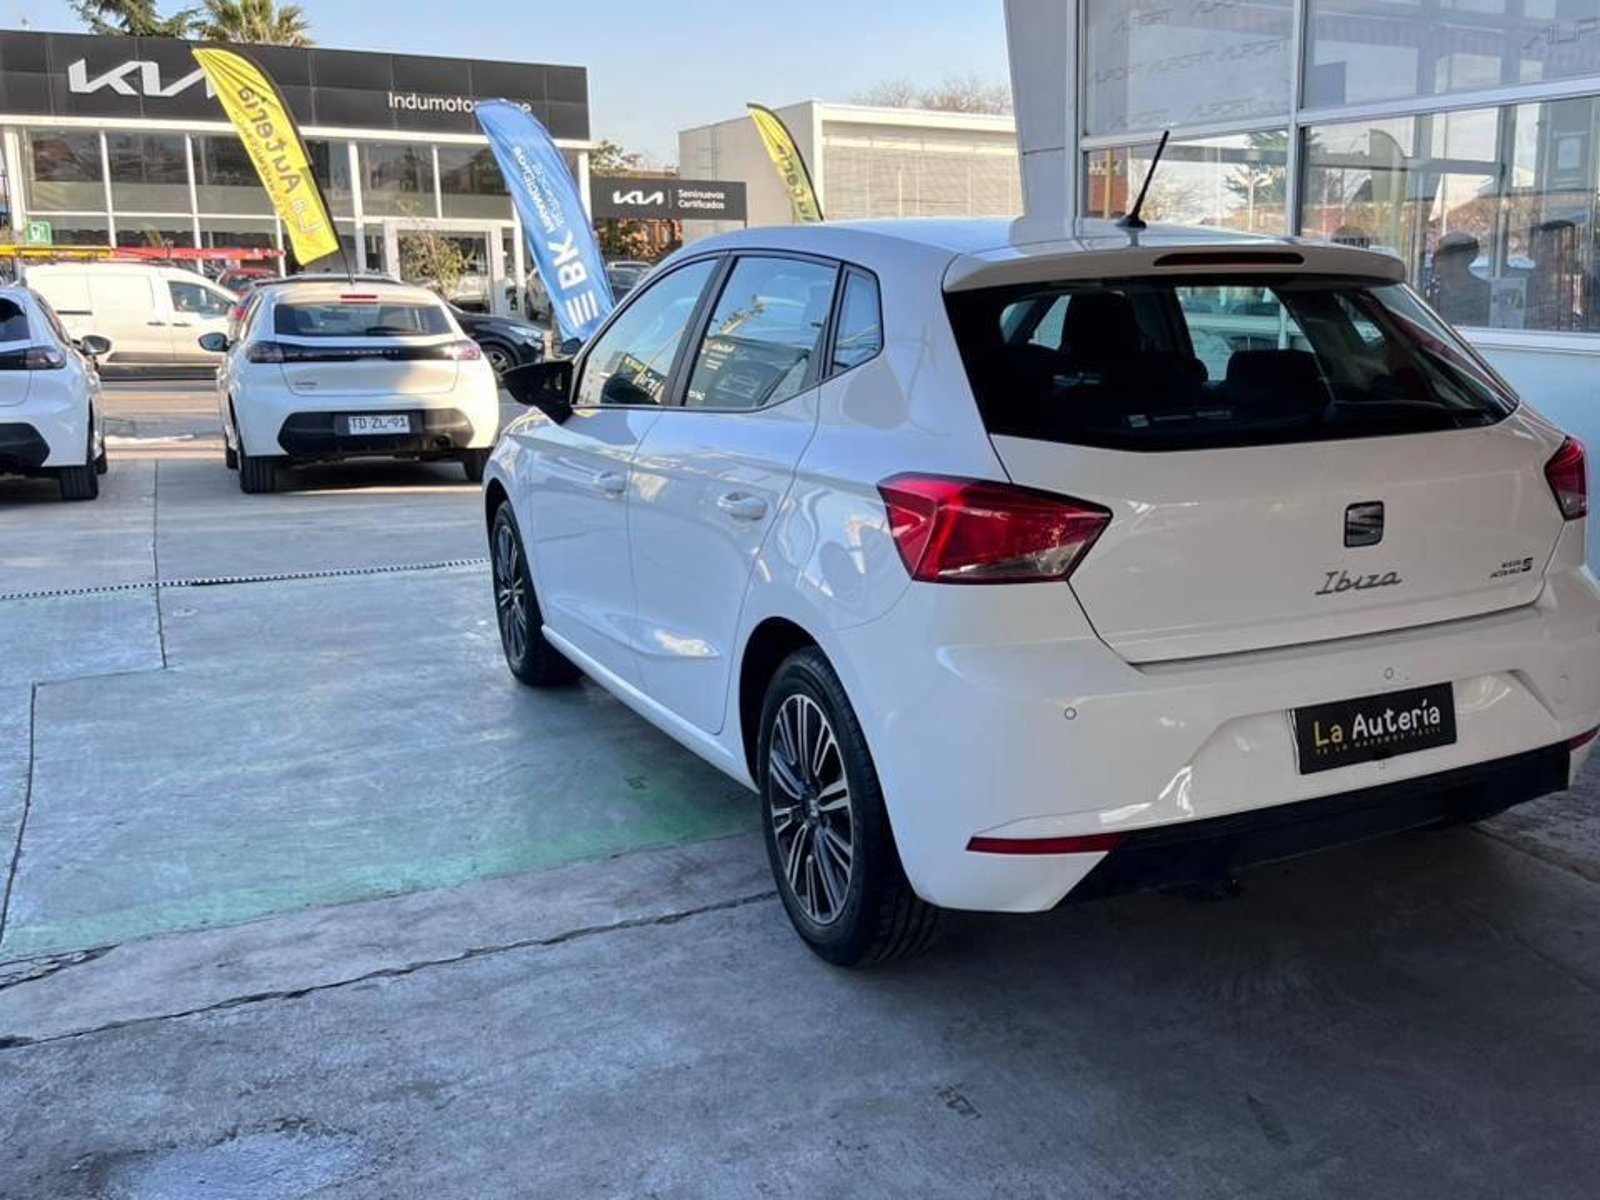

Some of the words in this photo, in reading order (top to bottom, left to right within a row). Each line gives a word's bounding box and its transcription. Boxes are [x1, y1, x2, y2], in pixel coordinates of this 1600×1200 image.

[1315, 570, 1403, 595] Ibiza
[1314, 720, 1343, 747] La
[1352, 698, 1441, 740] Autería
